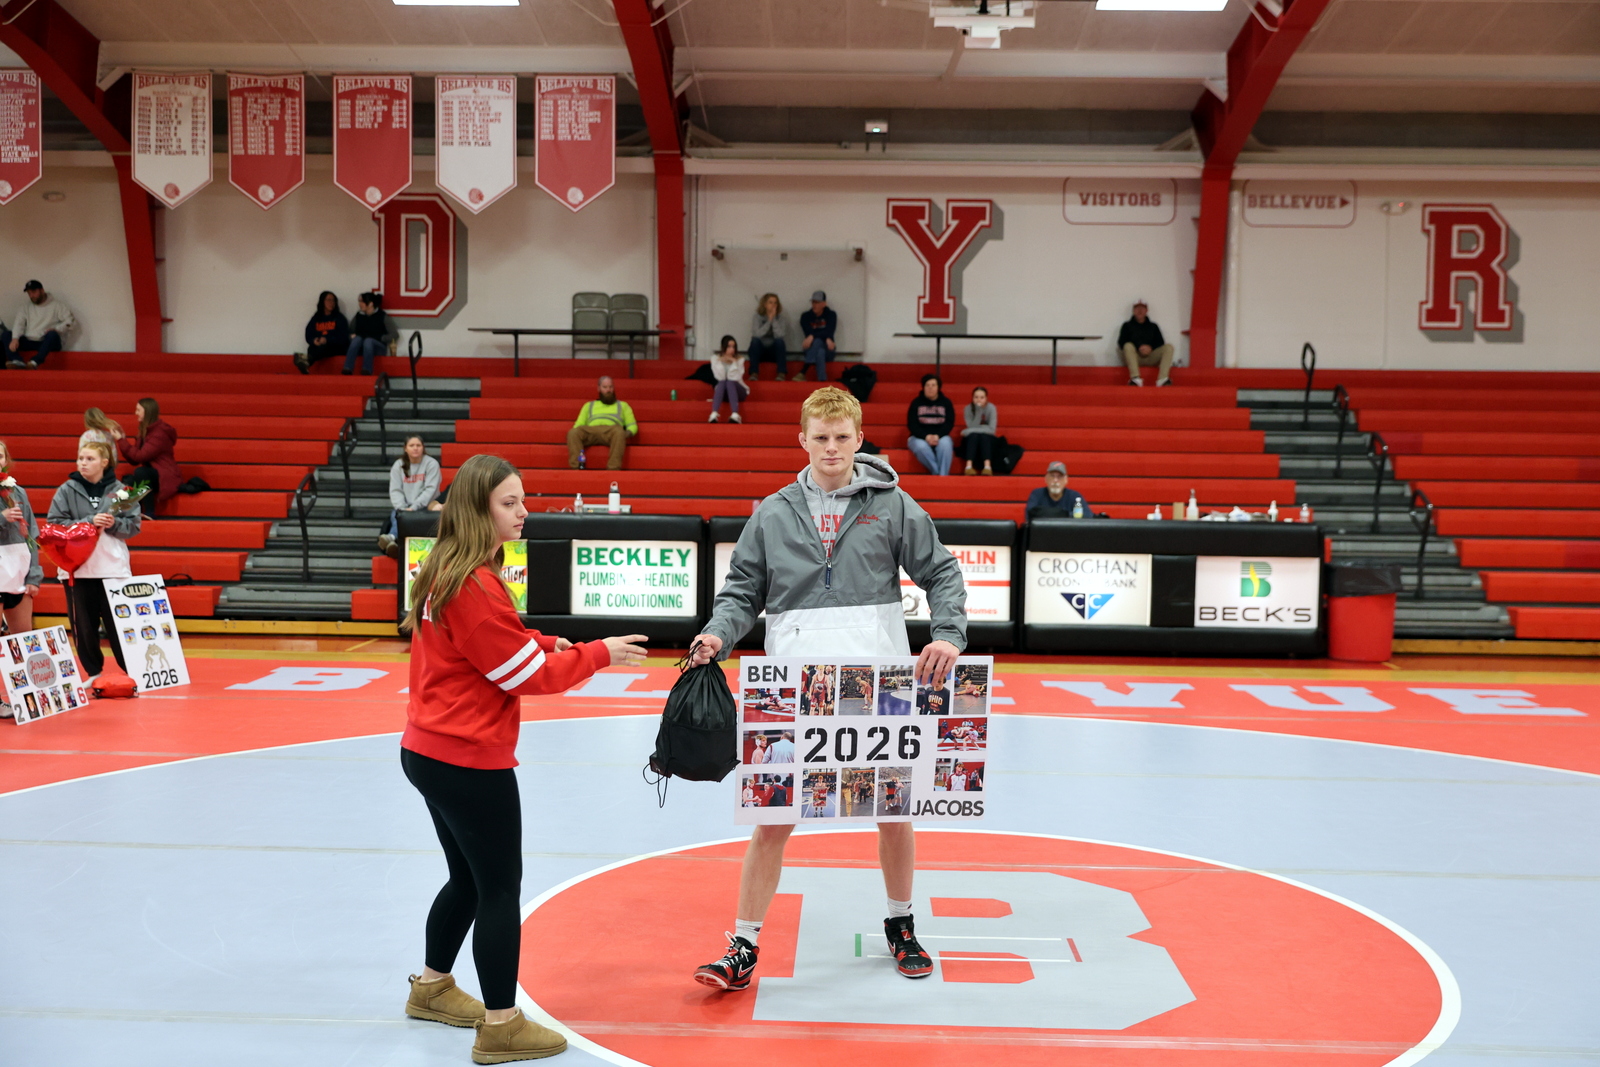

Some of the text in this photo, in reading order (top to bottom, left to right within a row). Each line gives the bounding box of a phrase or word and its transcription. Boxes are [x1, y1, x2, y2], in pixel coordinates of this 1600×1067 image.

[23, 73, 36, 86] HS
[138, 76, 207, 89] BELLEVUE HS
[230, 77, 300, 91] BELLEVUE HS
[338, 80, 408, 94] BELLEVUE HS
[441, 80, 511, 94] BELLEVUE HS
[540, 80, 611, 93] BELLEVUE HS
[1079, 192, 1161, 207] VISITORS
[1247, 194, 1336, 209] BELLEVUE
[372, 193, 456, 318] D
[886, 198, 992, 324] Y
[1418, 202, 1513, 332] R
[577, 547, 691, 567] BECKLEY
[1038, 558, 1138, 574] CROGHAN
[580, 572, 633, 586] PLUMBIN
[645, 572, 689, 587] HEATING
[1038, 576, 1094, 588] COLON
[123, 585, 154, 596] LILLIAN
[584, 593, 682, 608] AIR CONDITIONING
[1200, 606, 1312, 622] BECK'S
[142, 668, 178, 689] 2026
[748, 666, 788, 682] BEN
[224, 666, 1588, 717] BLVUE
[928, 694, 943, 705] OHIO
[804, 725, 922, 762] 2026
[912, 800, 984, 817] JACOBS
